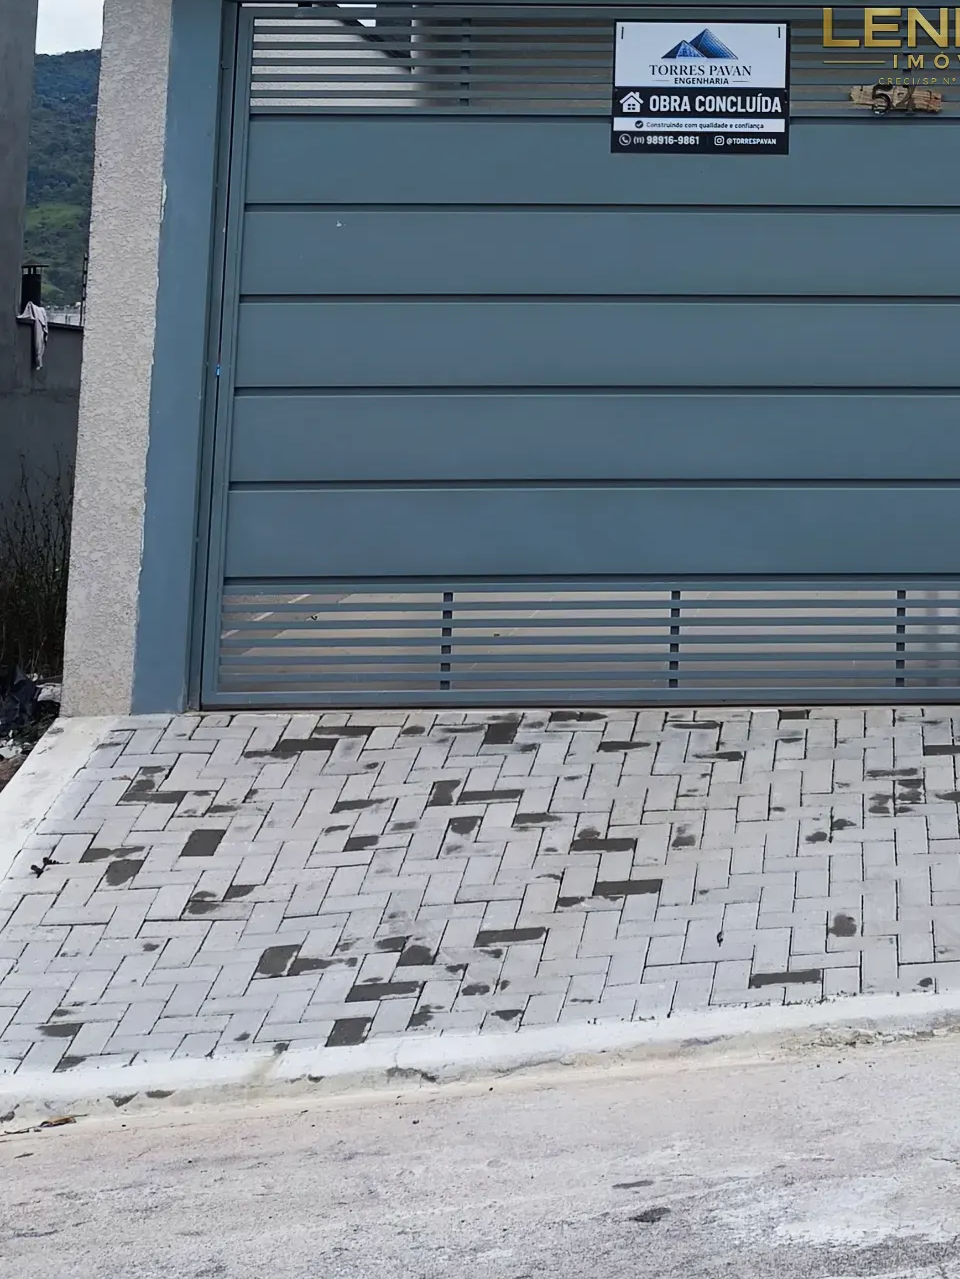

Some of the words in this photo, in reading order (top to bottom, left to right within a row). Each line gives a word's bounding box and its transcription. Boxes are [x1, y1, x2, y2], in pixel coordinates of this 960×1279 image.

[649, 65, 705, 76] TORRES
[709, 65, 752, 77] PAVAN
[674, 77, 729, 85] ENGENHARIA
[649, 95, 691, 112] OBRA
[695, 93, 782, 113] CONCLUÍDA
[699, 122, 728, 130] qualidade
[734, 123, 764, 131] confiança
[633, 136, 645, 145] (11)
[646, 135, 700, 145] 98916-9861
[726, 137, 777, 145] @TORRESPAVAN
